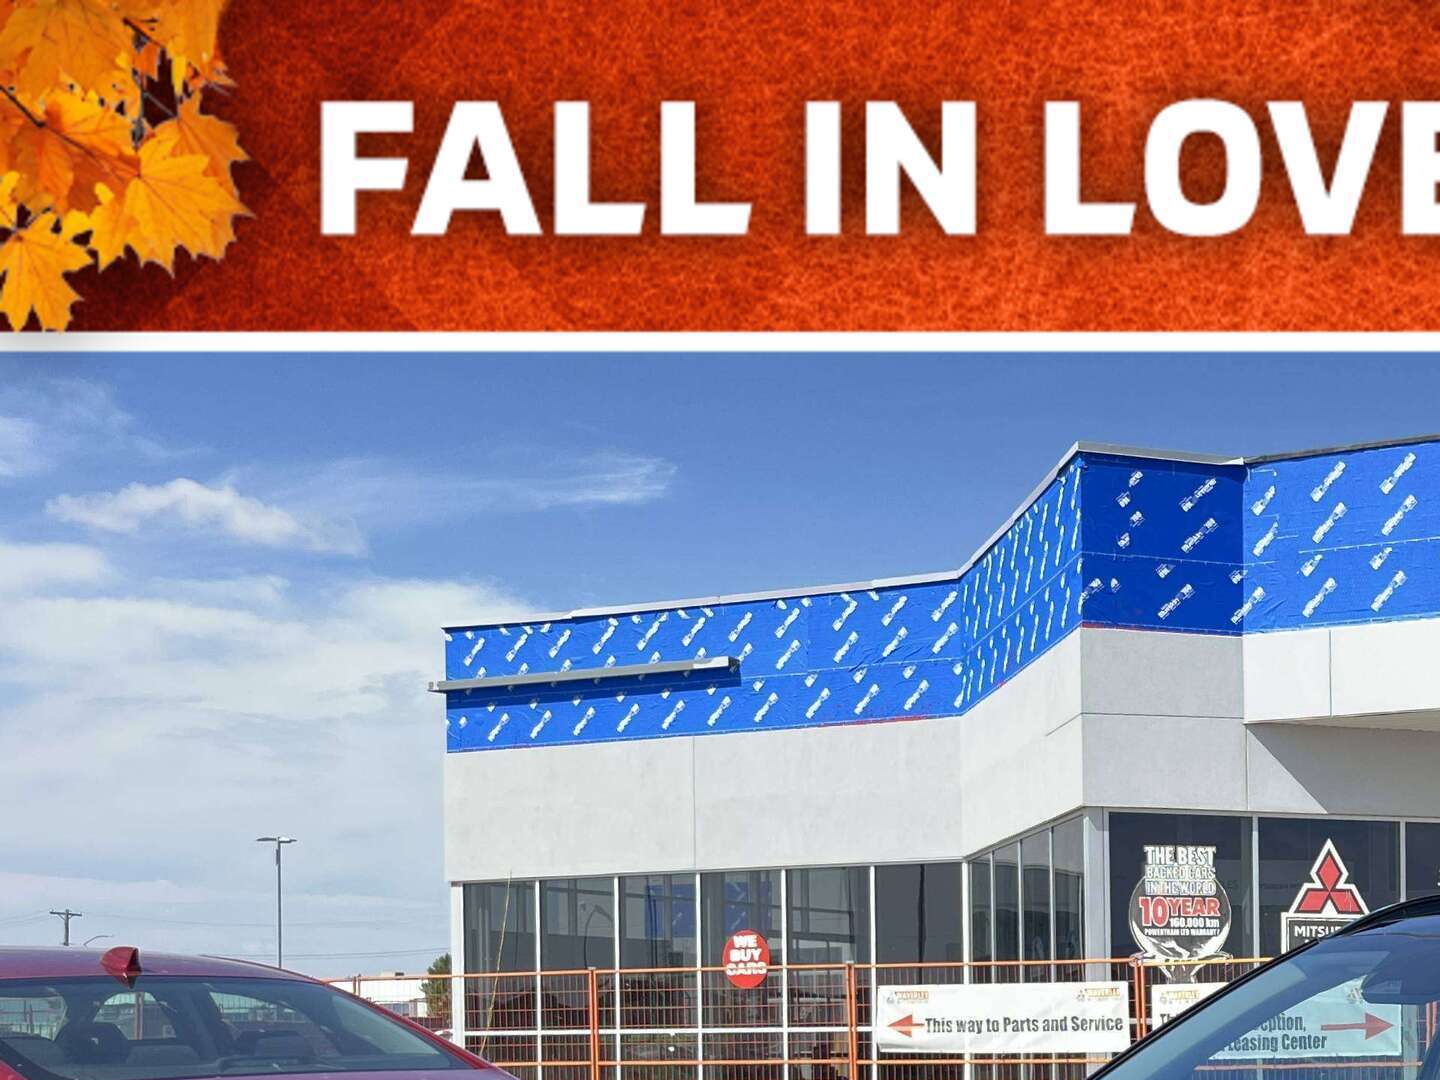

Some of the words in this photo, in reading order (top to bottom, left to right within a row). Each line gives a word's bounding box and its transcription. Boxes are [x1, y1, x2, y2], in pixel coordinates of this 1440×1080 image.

[1144, 845, 1174, 865] THE
[1177, 845, 1216, 866] BEST
[1145, 865, 1185, 880] BACKED
[1186, 866, 1216, 881] CARS
[1145, 880, 1157, 895] IN
[1157, 880, 1180, 895] THE
[1180, 880, 1217, 896] WORLD
[1138, 896, 1169, 928] 10
[1168, 896, 1221, 917] YEAR
[1170, 917, 1204, 928] 160,000
[1205, 917, 1220, 928] km
[733, 934, 758, 948] WE
[729, 948, 762, 962] BUY
[726, 961, 767, 976] CARS
[925, 1017, 953, 1034] This
[956, 1019, 982, 1035] way
[986, 1018, 999, 1033] to
[1003, 1016, 1039, 1033] Parts
[1042, 1016, 1067, 1032] and
[1071, 1015, 1123, 1032] Service
[1281, 1034, 1327, 1051] Center
